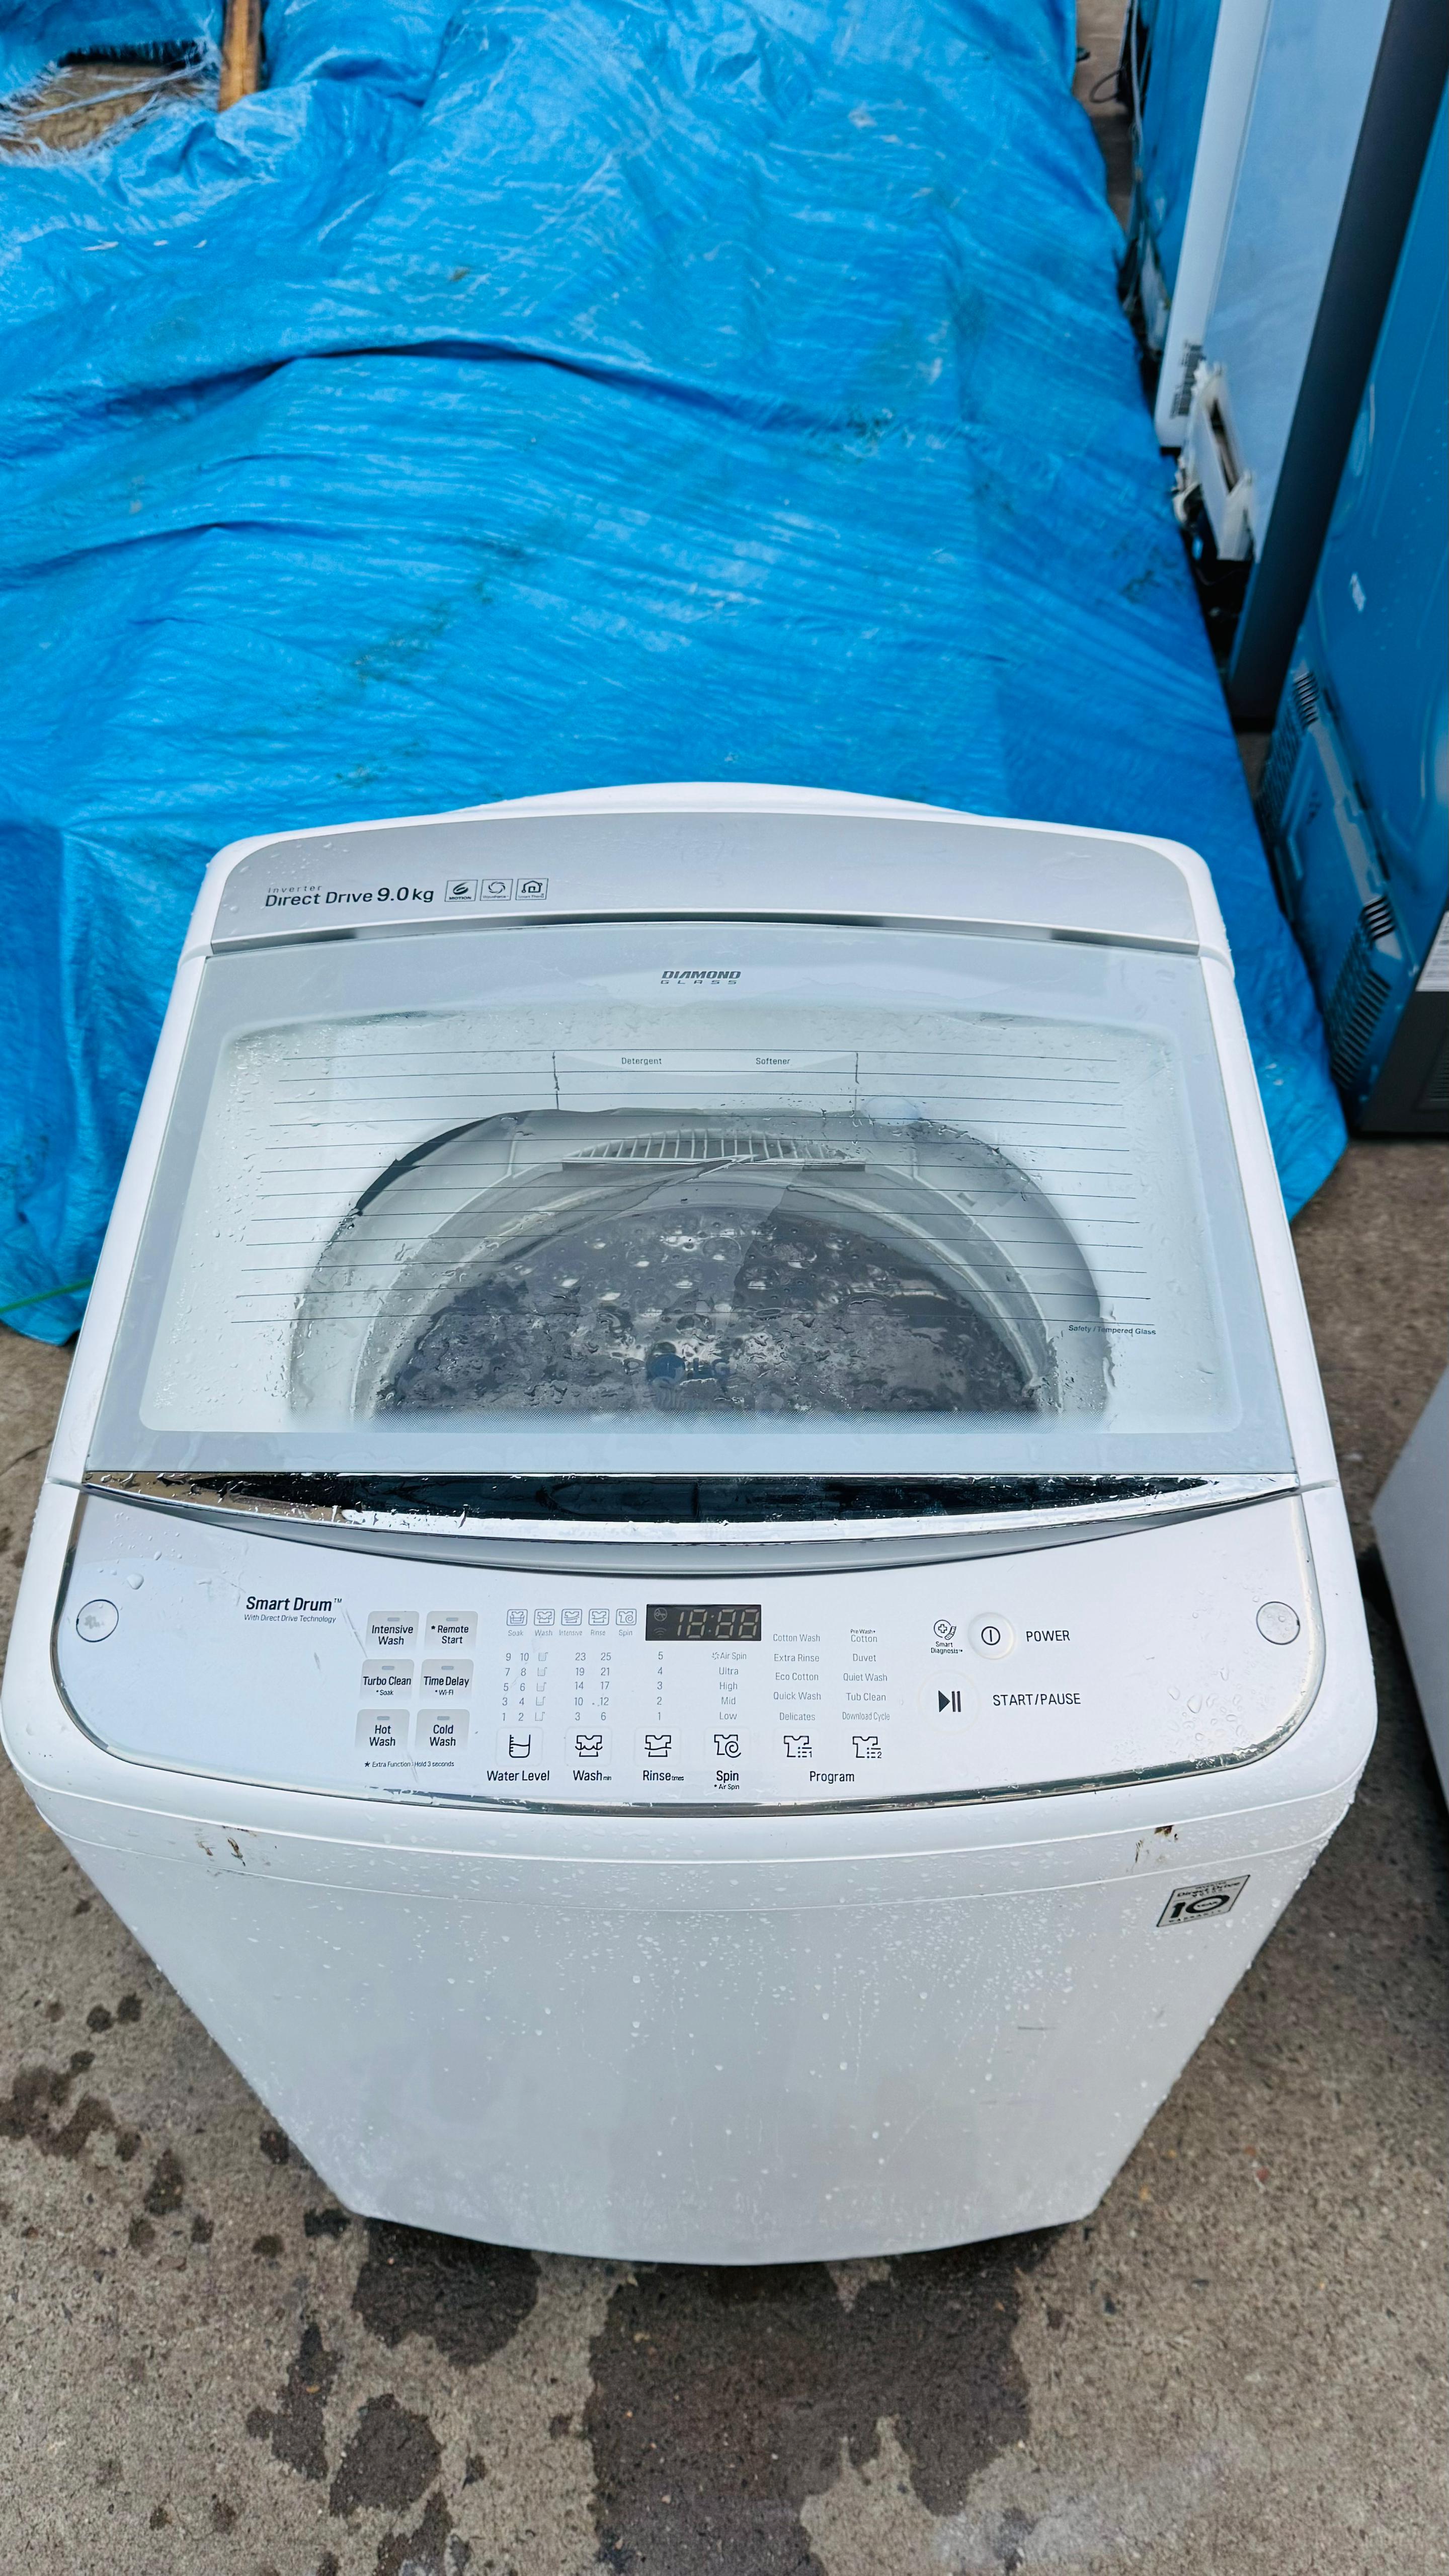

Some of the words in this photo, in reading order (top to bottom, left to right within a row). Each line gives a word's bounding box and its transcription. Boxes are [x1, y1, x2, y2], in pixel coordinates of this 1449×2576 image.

[268, 885, 322, 893] Inverter
[265, 894, 321, 907] Direct
[326, 892, 373, 904] Drive
[621, 1057, 662, 1065] Detergent
[1068, 1325, 1092, 1333] Safety
[246, 1596, 290, 1611] Smart
[299, 1615, 337, 1624] Technology
[372, 1625, 414, 1634] Intensive
[378, 1636, 405, 1645] Wash
[442, 1636, 463, 1644] Start
[773, 1634, 797, 1642] Cotton
[1026, 1630, 1070, 1642] POWER
[506, 1653, 511, 1661] 9
[520, 1653, 529, 1661] 10
[575, 1652, 586, 1661] 23
[601, 1652, 611, 1661] 25
[658, 1651, 663, 1660] 5
[732, 1652, 747, 1661] Spin
[797, 1654, 820, 1662] Rinse
[852, 1653, 876, 1662] Duvet
[505, 1667, 510, 1676] 7
[521, 1667, 526, 1676] 8
[576, 1667, 585, 1676] 19
[601, 1667, 610, 1676] 21
[658, 1666, 663, 1674] 4
[719, 1667, 739, 1675] Ultra
[363, 1676, 387, 1685] Turbo
[388, 1676, 412, 1685] Clean
[775, 1672, 790, 1680] Eco
[792, 1672, 819, 1681] Cotton
[843, 1672, 863, 1681] Quiet
[864, 1673, 888, 1681] Wash
[424, 1676, 444, 1685] Time
[446, 1676, 469, 1687] Delay
[575, 1681, 584, 1690] 14
[601, 1681, 610, 1690] 17
[657, 1681, 663, 1690] 3
[504, 1682, 509, 1692] 5
[520, 1682, 525, 1691] 6
[719, 1682, 738, 1691] High
[773, 1692, 796, 1700] Quick
[798, 1692, 821, 1700] Wash
[846, 1693, 861, 1701] Tub
[863, 1693, 886, 1701] Clean
[993, 1693, 1081, 1706] START/PAUSE
[502, 1697, 508, 1706] 3
[519, 1697, 524, 1706] 4
[575, 1697, 583, 1706] 10
[600, 1697, 609, 1706] 12
[657, 1697, 662, 1705] 2
[721, 1697, 736, 1705] Mid
[503, 1713, 506, 1721] 1
[518, 1713, 524, 1721] 2
[575, 1712, 580, 1721] 3
[601, 1712, 606, 1721] 6
[658, 1712, 661, 1721] 1
[719, 1712, 738, 1720] Low
[779, 1712, 816, 1721] Delicates
[842, 1711, 872, 1721] Download
[873, 1712, 890, 1722] Cycle
[375, 1725, 391, 1734] Hot
[433, 1725, 454, 1734] Cold
[369, 1737, 396, 1746] Wash
[430, 1737, 456, 1746] Wash
[487, 1770, 519, 1781] Water
[522, 1770, 550, 1781] Level
[573, 1770, 602, 1781] Wash
[642, 1770, 671, 1781] Rinse
[716, 1770, 739, 1784] Spin
[810, 1771, 855, 1784] Program
